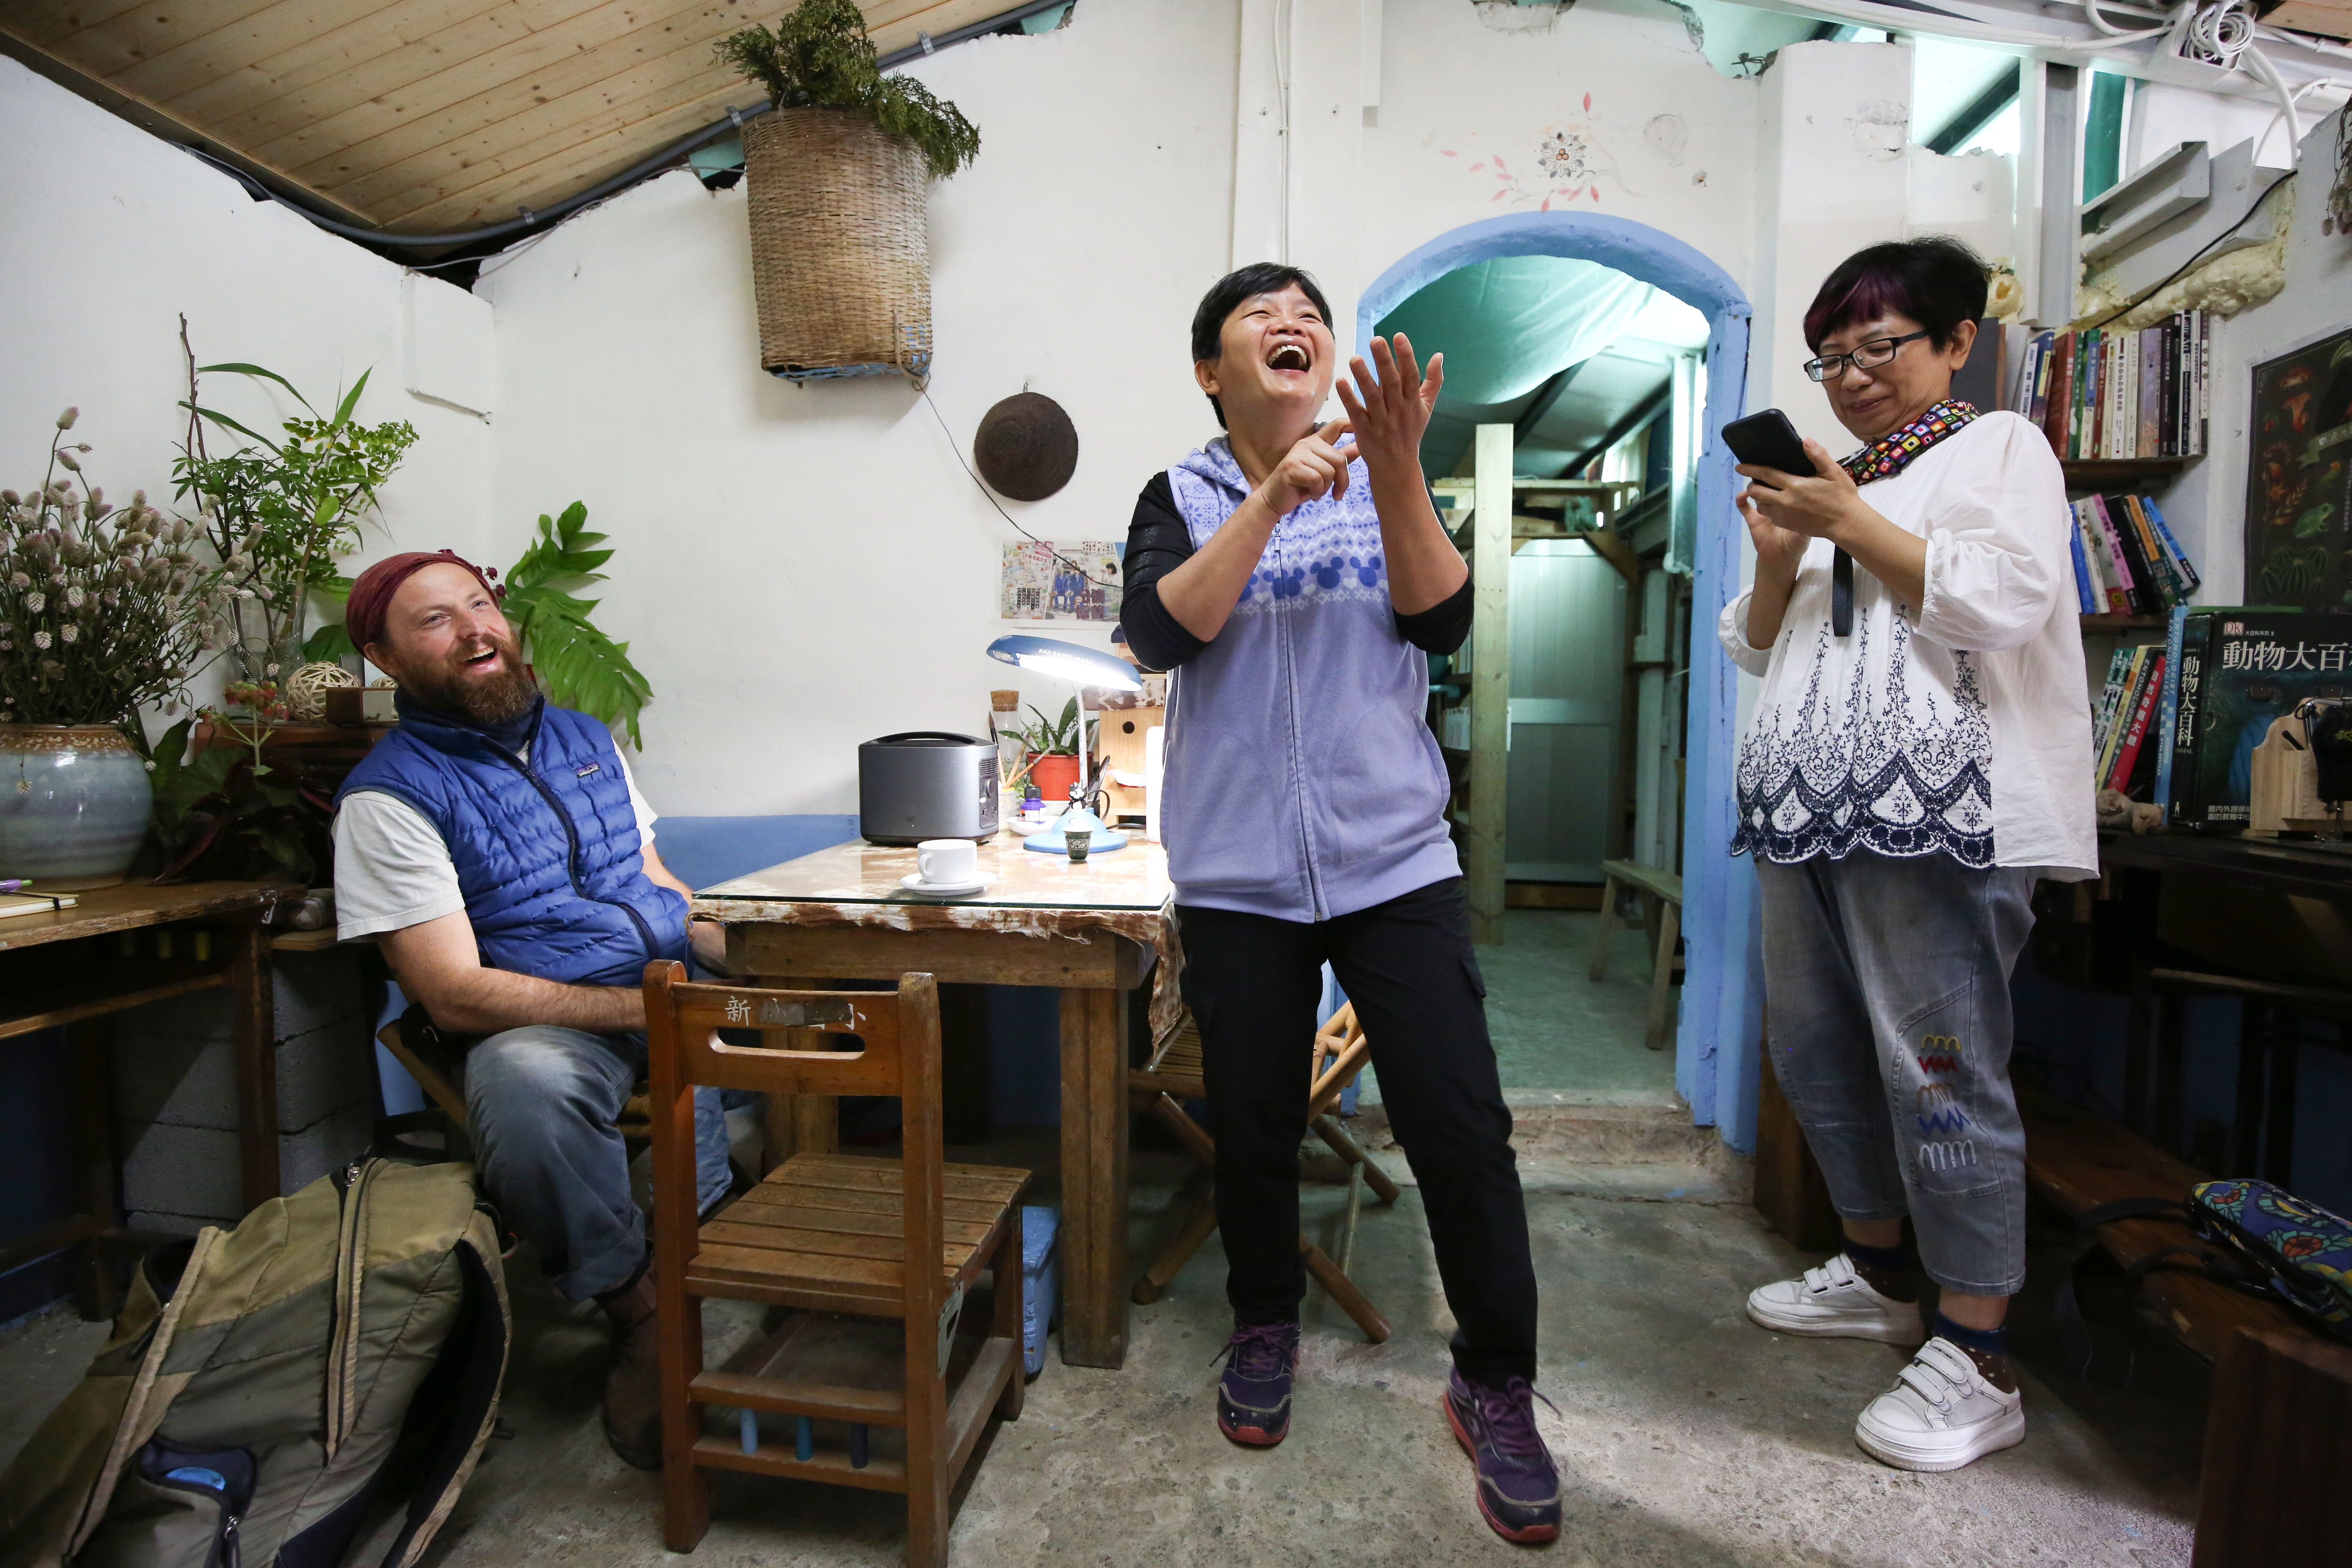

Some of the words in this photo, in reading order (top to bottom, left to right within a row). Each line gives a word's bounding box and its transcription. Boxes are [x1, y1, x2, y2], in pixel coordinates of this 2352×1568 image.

[2226, 623, 2241, 633] DK
[1052, 651, 1094, 665] BADTZ-MARU
[2223, 641, 2352, 671] 動物大百
[2177, 656, 2200, 746] 動物大百科
